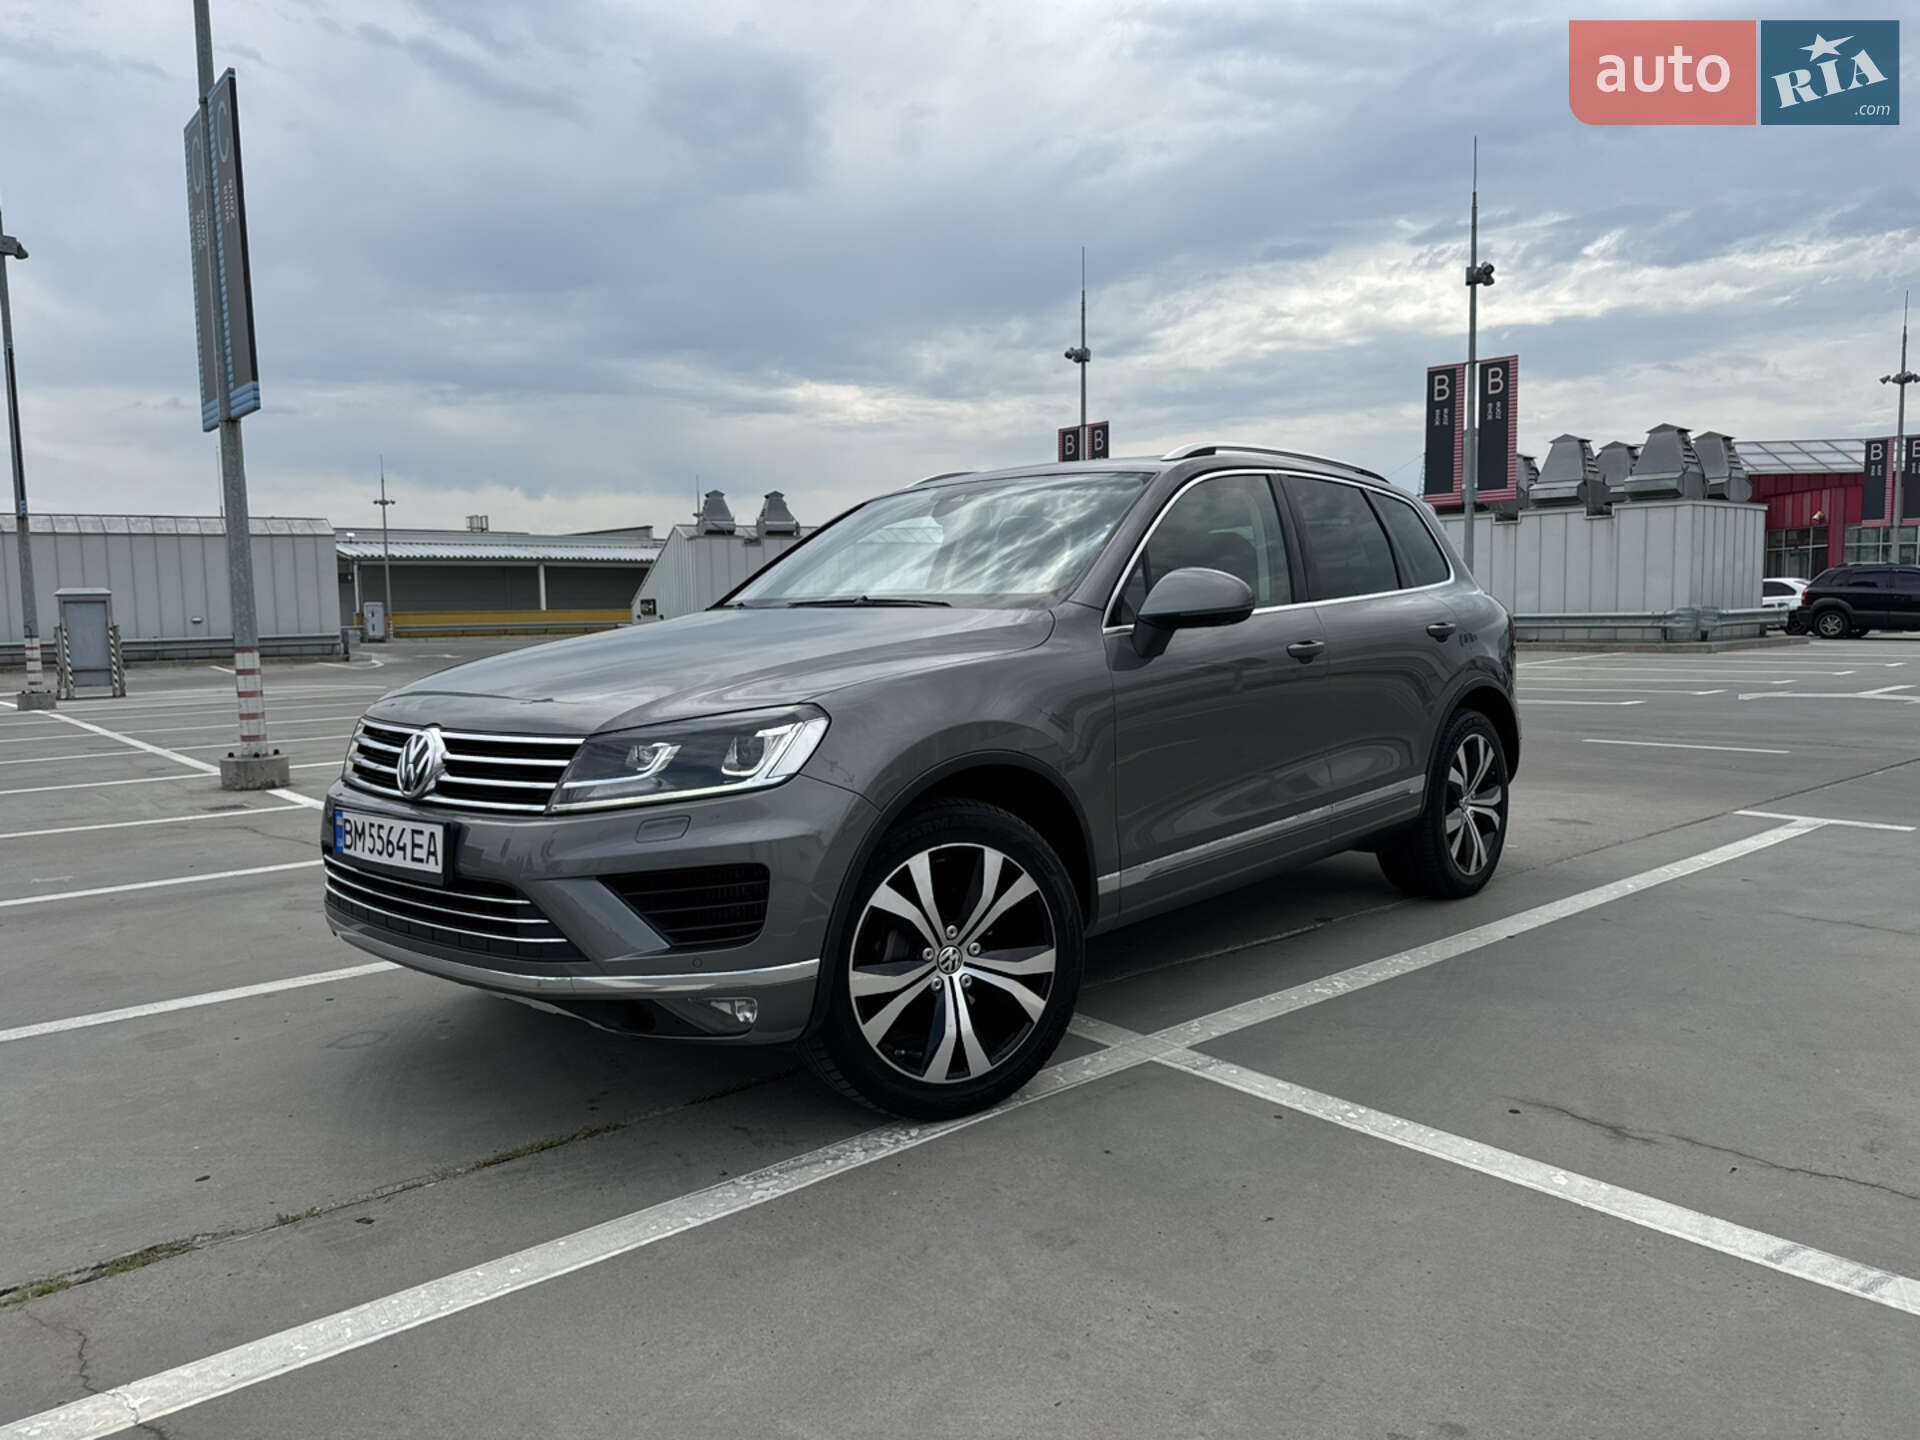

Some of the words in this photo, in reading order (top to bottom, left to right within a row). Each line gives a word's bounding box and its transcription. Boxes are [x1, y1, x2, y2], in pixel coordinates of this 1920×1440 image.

[1433, 374, 1450, 402] B
[1487, 367, 1504, 395] B
[1065, 434, 1075, 456] B
[1094, 429, 1104, 452] B
[1870, 443, 1883, 461] B
[343, 817, 439, 867] BM5564EA
